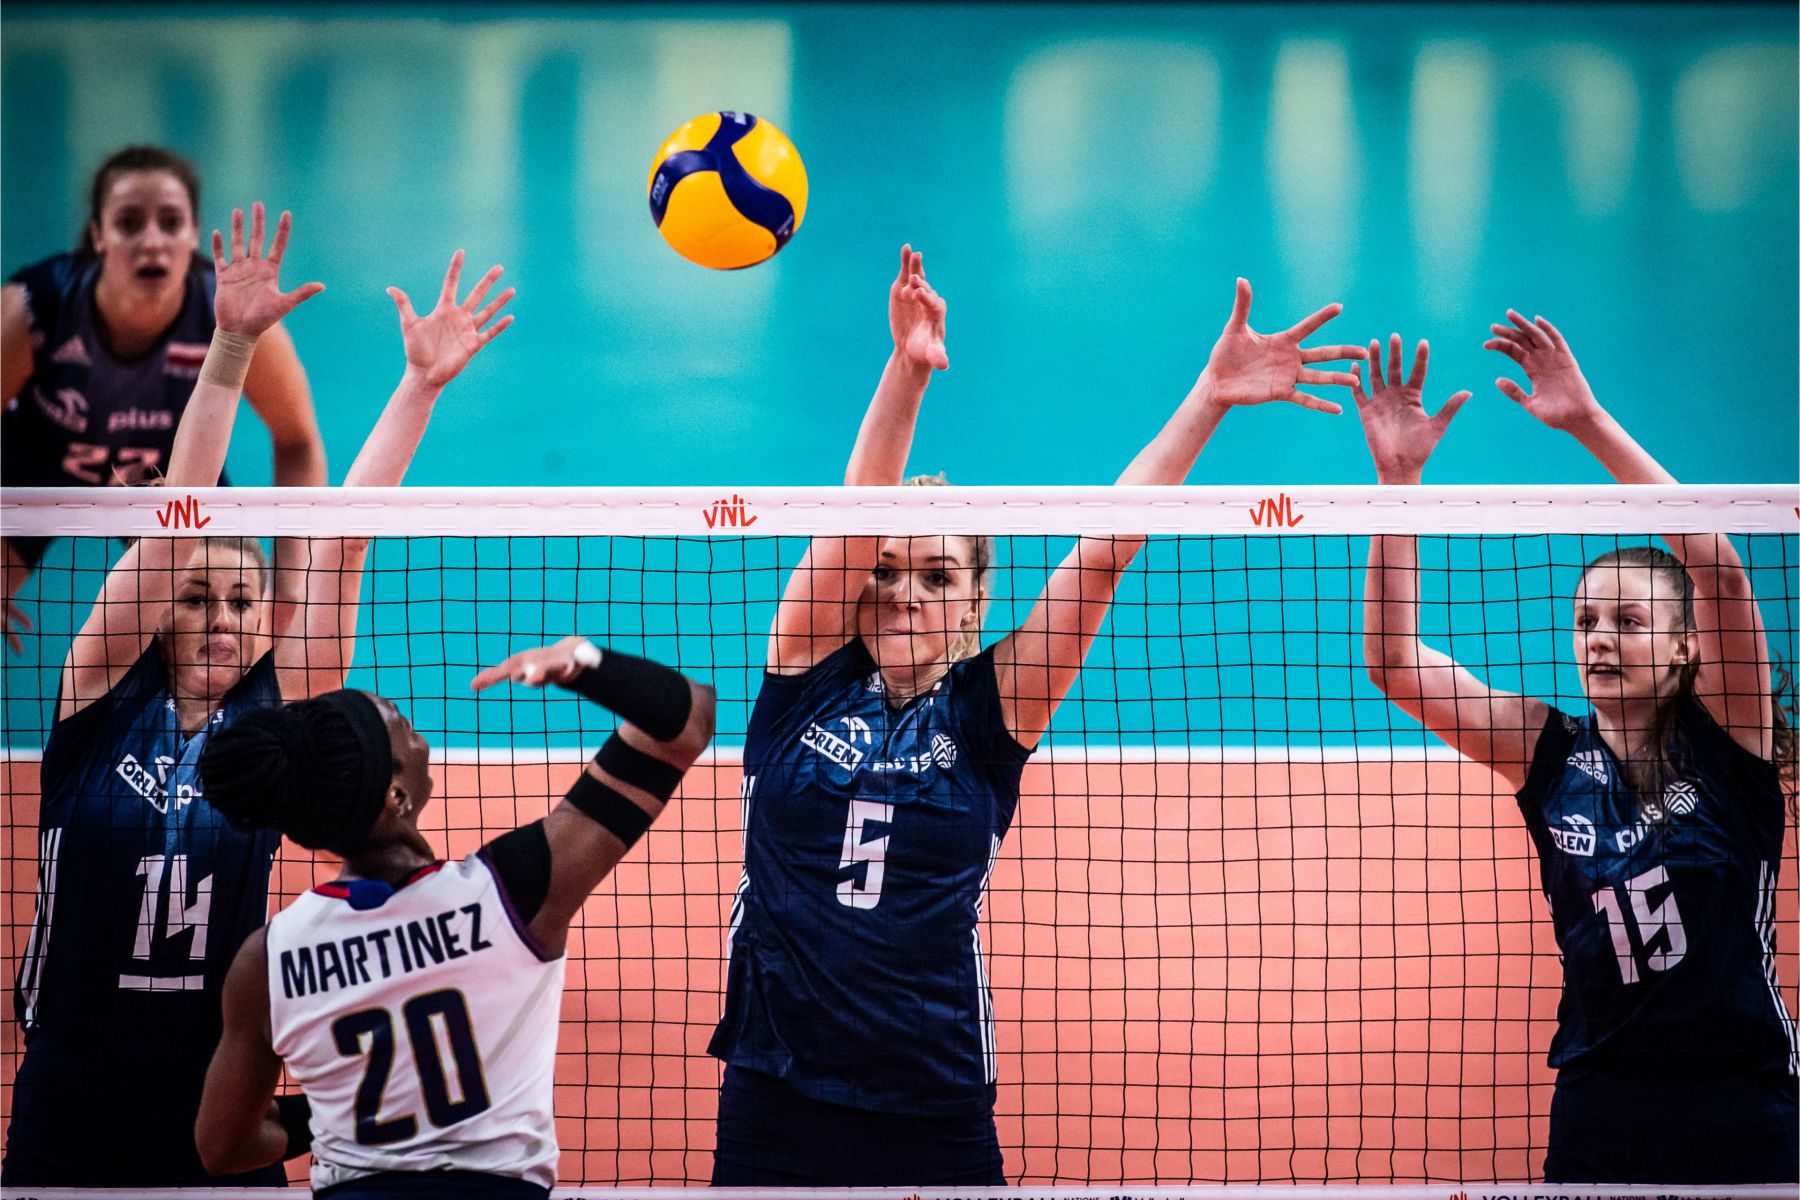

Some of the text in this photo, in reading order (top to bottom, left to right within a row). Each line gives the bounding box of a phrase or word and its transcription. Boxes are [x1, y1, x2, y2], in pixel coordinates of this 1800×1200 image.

[107, 407, 173, 433] plus
[156, 494, 212, 530] VNL
[702, 493, 758, 530] VNL
[1248, 492, 1304, 528] VNL
[803, 725, 859, 766] ORLEN
[1566, 756, 1609, 785] adidas
[836, 799, 895, 910] 5
[1551, 831, 1592, 854] RLEN
[132, 854, 213, 960] 14
[1591, 864, 1688, 985] 15
[279, 902, 493, 999] MARTINEZ
[330, 987, 492, 1146] 20
